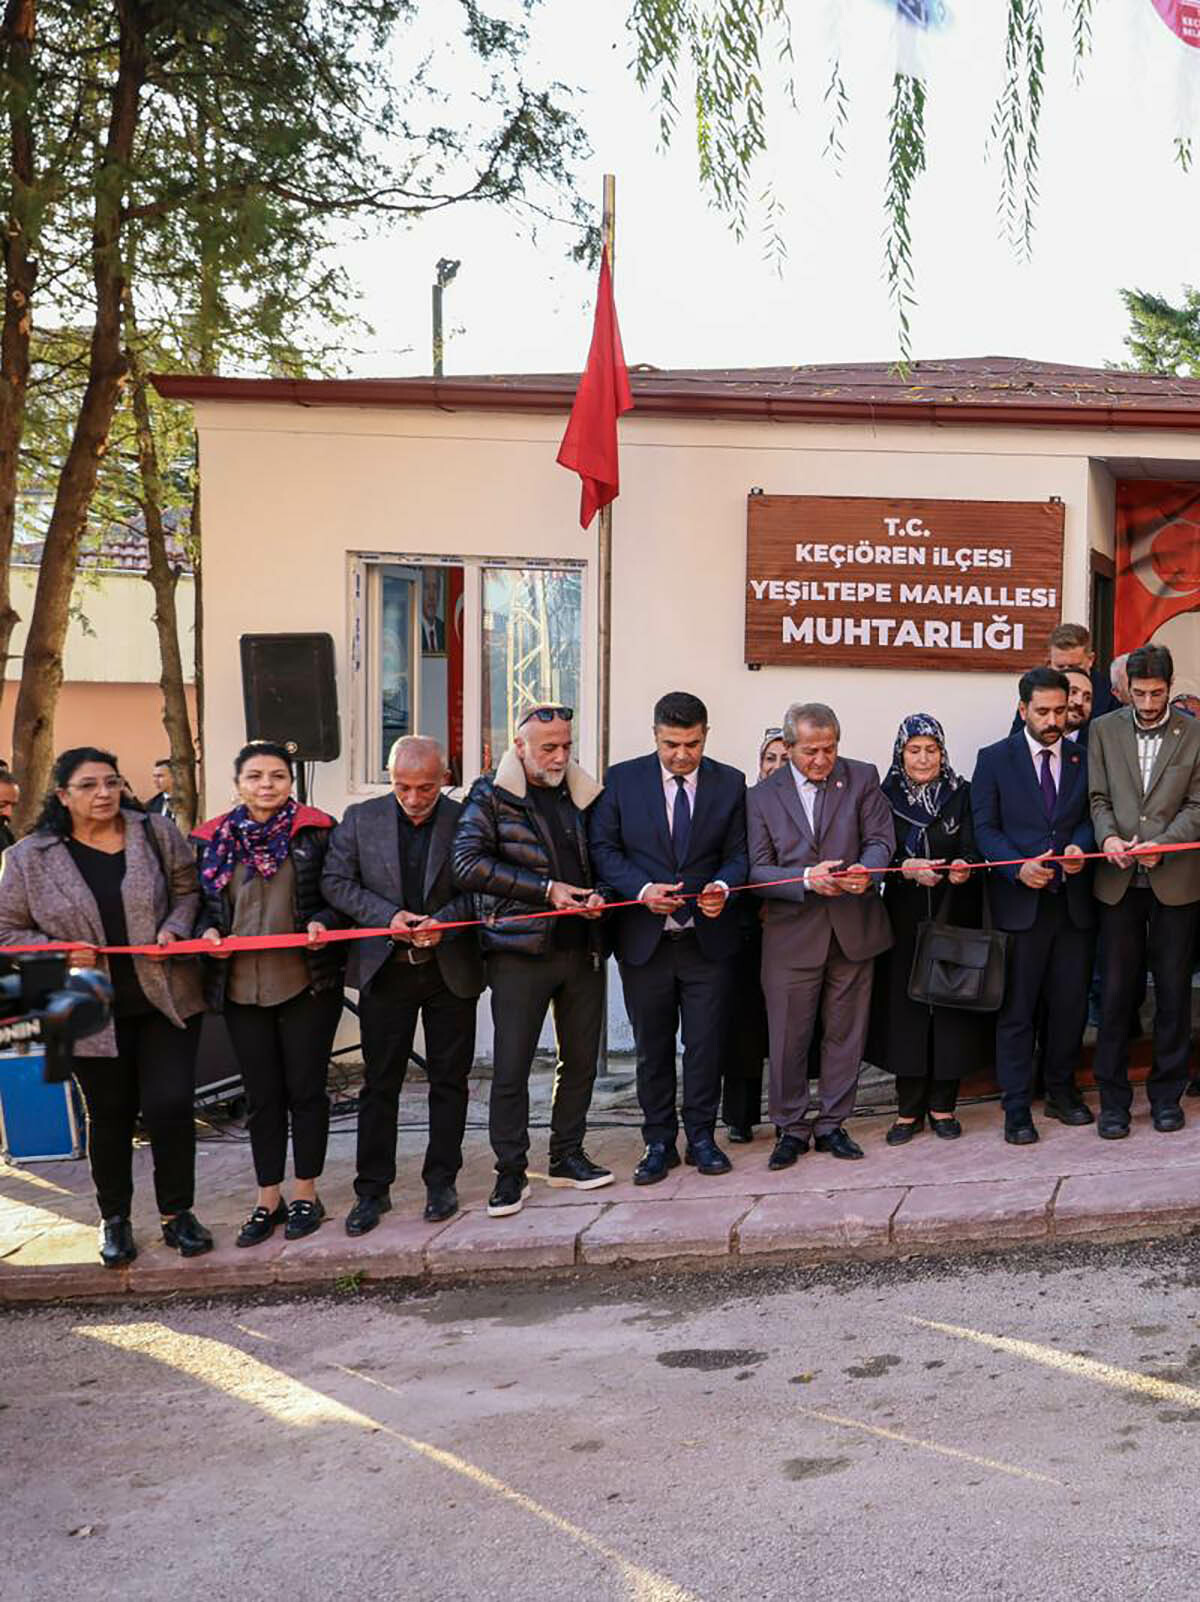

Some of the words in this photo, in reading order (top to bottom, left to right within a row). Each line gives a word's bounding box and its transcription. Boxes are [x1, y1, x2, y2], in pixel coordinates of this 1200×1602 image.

[884, 518, 931, 537] T.C.
[795, 540, 926, 568] KEÇİÖREN
[932, 547, 1012, 572] İLÇESİ
[750, 580, 892, 606] YEŞİLTEPE
[900, 584, 1057, 608] MAHALLESİ
[782, 614, 1024, 650] MUHTARLIĞI
